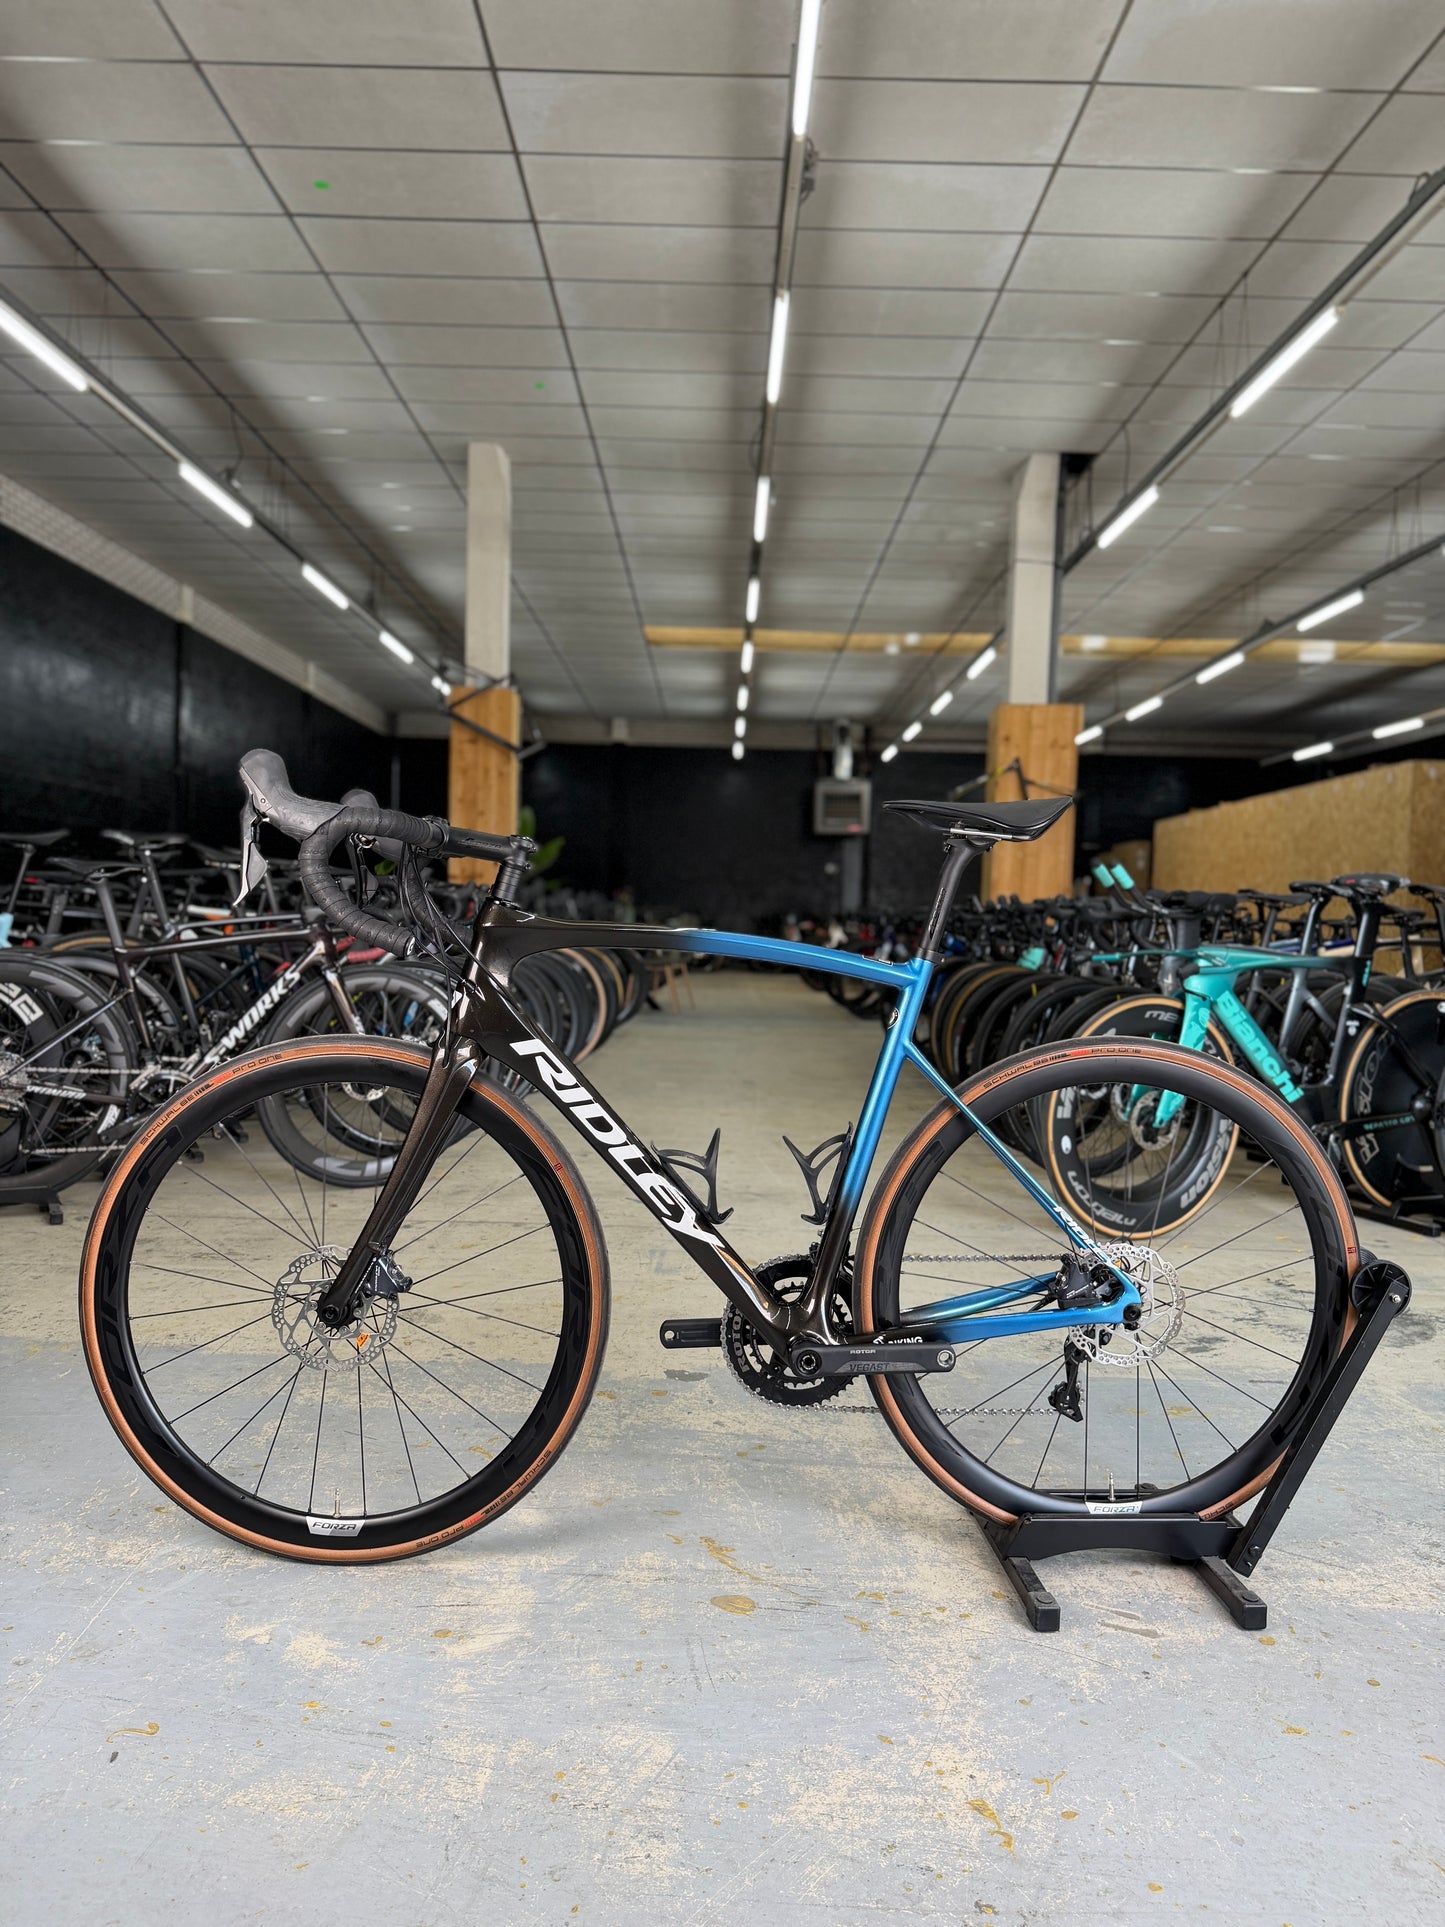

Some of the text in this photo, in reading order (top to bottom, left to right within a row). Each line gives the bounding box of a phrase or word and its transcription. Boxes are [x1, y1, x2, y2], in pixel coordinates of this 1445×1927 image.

[203, 964, 301, 1067] S-WORKS
[1216, 990, 1305, 1104] Bianchi
[983, 1057, 1049, 1090] SCHWALBE
[140, 1096, 195, 1146] SCHWALBE
[509, 1038, 725, 1248] RIDLEY
[849, 1362, 890, 1372] VEGAST
[500, 1450, 552, 1503] SCHWALBE
[312, 1521, 357, 1531] FORZA
[1093, 1505, 1136, 1514] FORZA
